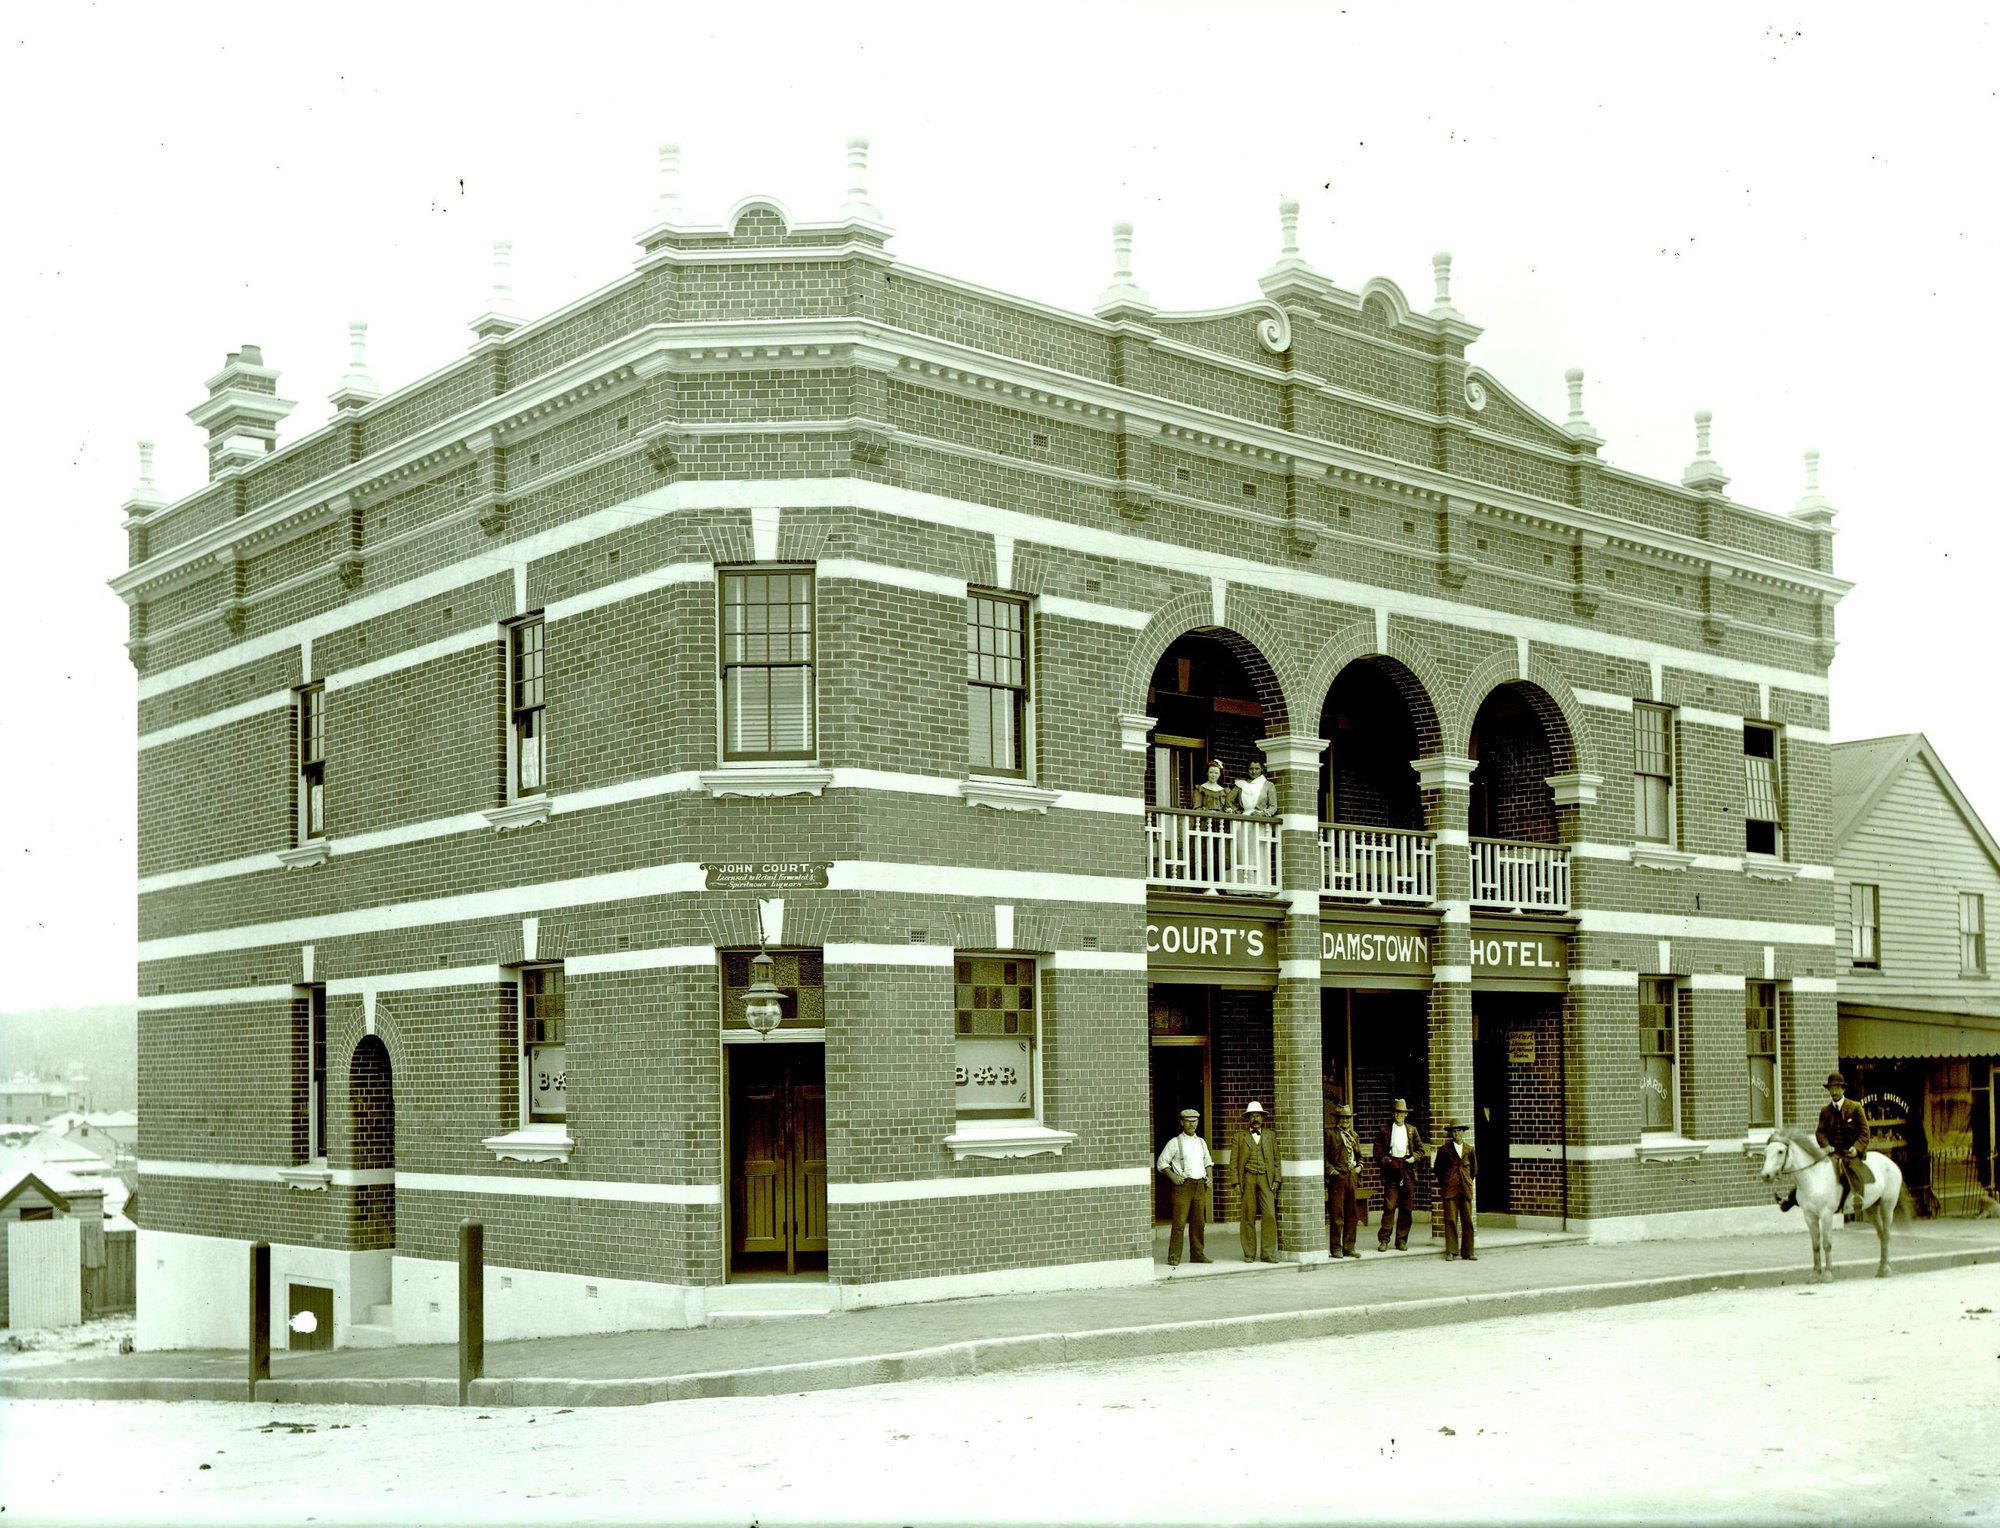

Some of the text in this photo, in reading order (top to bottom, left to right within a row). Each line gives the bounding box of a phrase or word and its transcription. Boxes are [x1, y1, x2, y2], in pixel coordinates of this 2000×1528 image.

[719, 864, 814, 873] JOHN COURT,
[1147, 925, 1560, 967] COURT'S DAMSTOWN HOTEL.
[955, 1065, 1018, 1086] BAR
